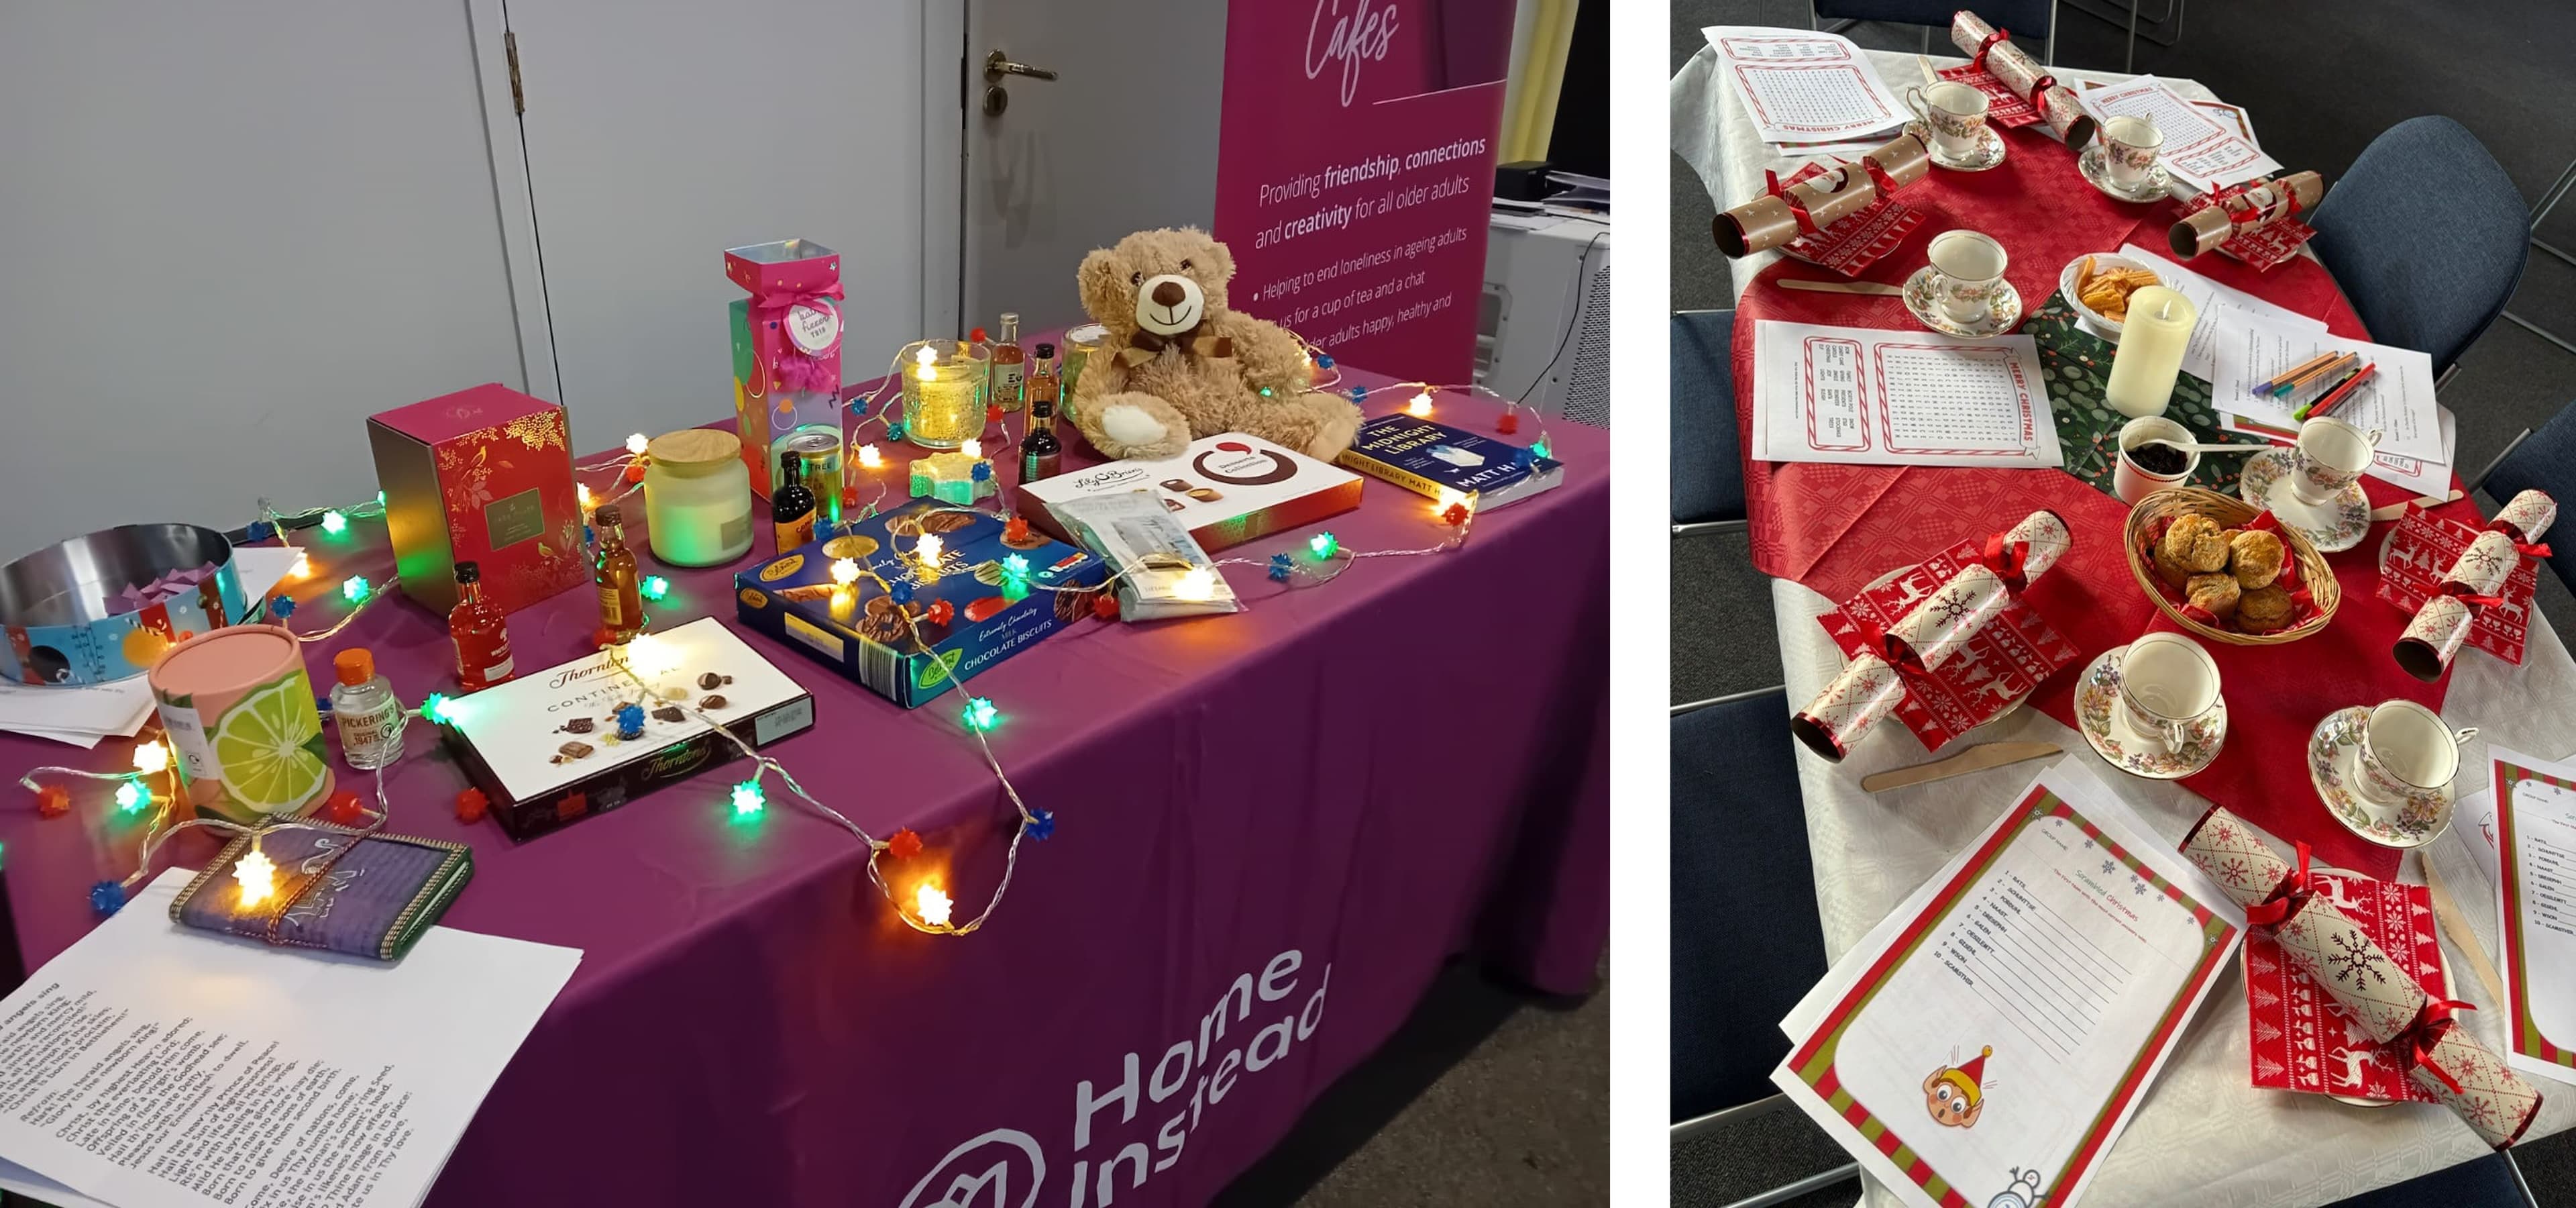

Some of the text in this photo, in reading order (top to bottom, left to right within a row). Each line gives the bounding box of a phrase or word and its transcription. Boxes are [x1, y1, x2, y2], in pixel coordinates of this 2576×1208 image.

[1845, 119, 1876, 130] MERRY
[1260, 138, 1486, 207] Providing friendship, connections
[1256, 173, 1470, 250] and creativity for all older adults
[1263, 227, 1467, 301] Helping to end loneliness in ageing adults
[1295, 307, 1309, 325] for
[1312, 307, 1320, 319] a
[1322, 299, 1341, 317] cup
[1344, 289, 1356, 309] of
[1356, 289, 1373, 305] tea
[1375, 276, 1395, 298] and
[1396, 279, 1403, 291] a
[1405, 270, 1426, 289] chat
[1330, 324, 1360, 347] adults
[1362, 315, 1394, 339] happy,
[1397, 301, 1432, 323] healthy
[1433, 291, 1452, 311] and
[2010, 362, 2033, 441] MERRY CHRISTMAS
[1361, 424, 1436, 452] MIDNIGHT
[1367, 425, 1401, 438] THE
[1385, 432, 1448, 456] LIBRARY
[1371, 464, 1407, 482] LIBRARY
[1409, 478, 1432, 492] MATT
[1456, 467, 1499, 488] MATT
[965, 619, 1053, 670] CHOCOLATE BISCUITS
[549, 654, 629, 689] Thornton
[2041, 828, 2056, 840] GROUP
[2012, 876, 2026, 889] RATS
[2074, 869, 2139, 921] Scrambled Christmas
[1974, 920, 1991, 935] GALEN
[1989, 901, 2008, 919] NAAST
[1933, 950, 1941, 958] 10
[1949, 947, 1967, 964] WSON
[1074, 949, 1303, 1152] Home
[66, 1117, 95, 1142] Christ
[93, 1102, 111, 1115] the
[111, 1060, 159, 1101] everlasting
[74, 1127, 99, 1147] Late
[97, 1117, 109, 1126] in
[131, 1066, 162, 1094] behold
[160, 1052, 180, 1066] Him
[85, 1098, 101, 1109] by
[99, 1070, 133, 1098] highest
[1072, 963, 1332, 1208] Instead
[86, 1113, 131, 1151] Offspring
[128, 1102, 139, 1112] of
[191, 1170, 211, 1191] Mild
[209, 1156, 224, 1169] He
[221, 1137, 241, 1154] lays
[238, 1121, 254, 1134] His
[253, 1098, 274, 1119] glory
[201, 1173, 225, 1195] Born
[222, 1151, 242, 1170] that
[241, 1130, 260, 1150] man
[259, 1117, 271, 1129] no
[270, 1093, 291, 1116] more
[290, 1075, 309, 1092] may
[223, 1182, 247, 1204] Born
[244, 1168, 256, 1179] to
[255, 1147, 274, 1168] give
[271, 1122, 294, 1146] them
[292, 1091, 321, 1121] second
